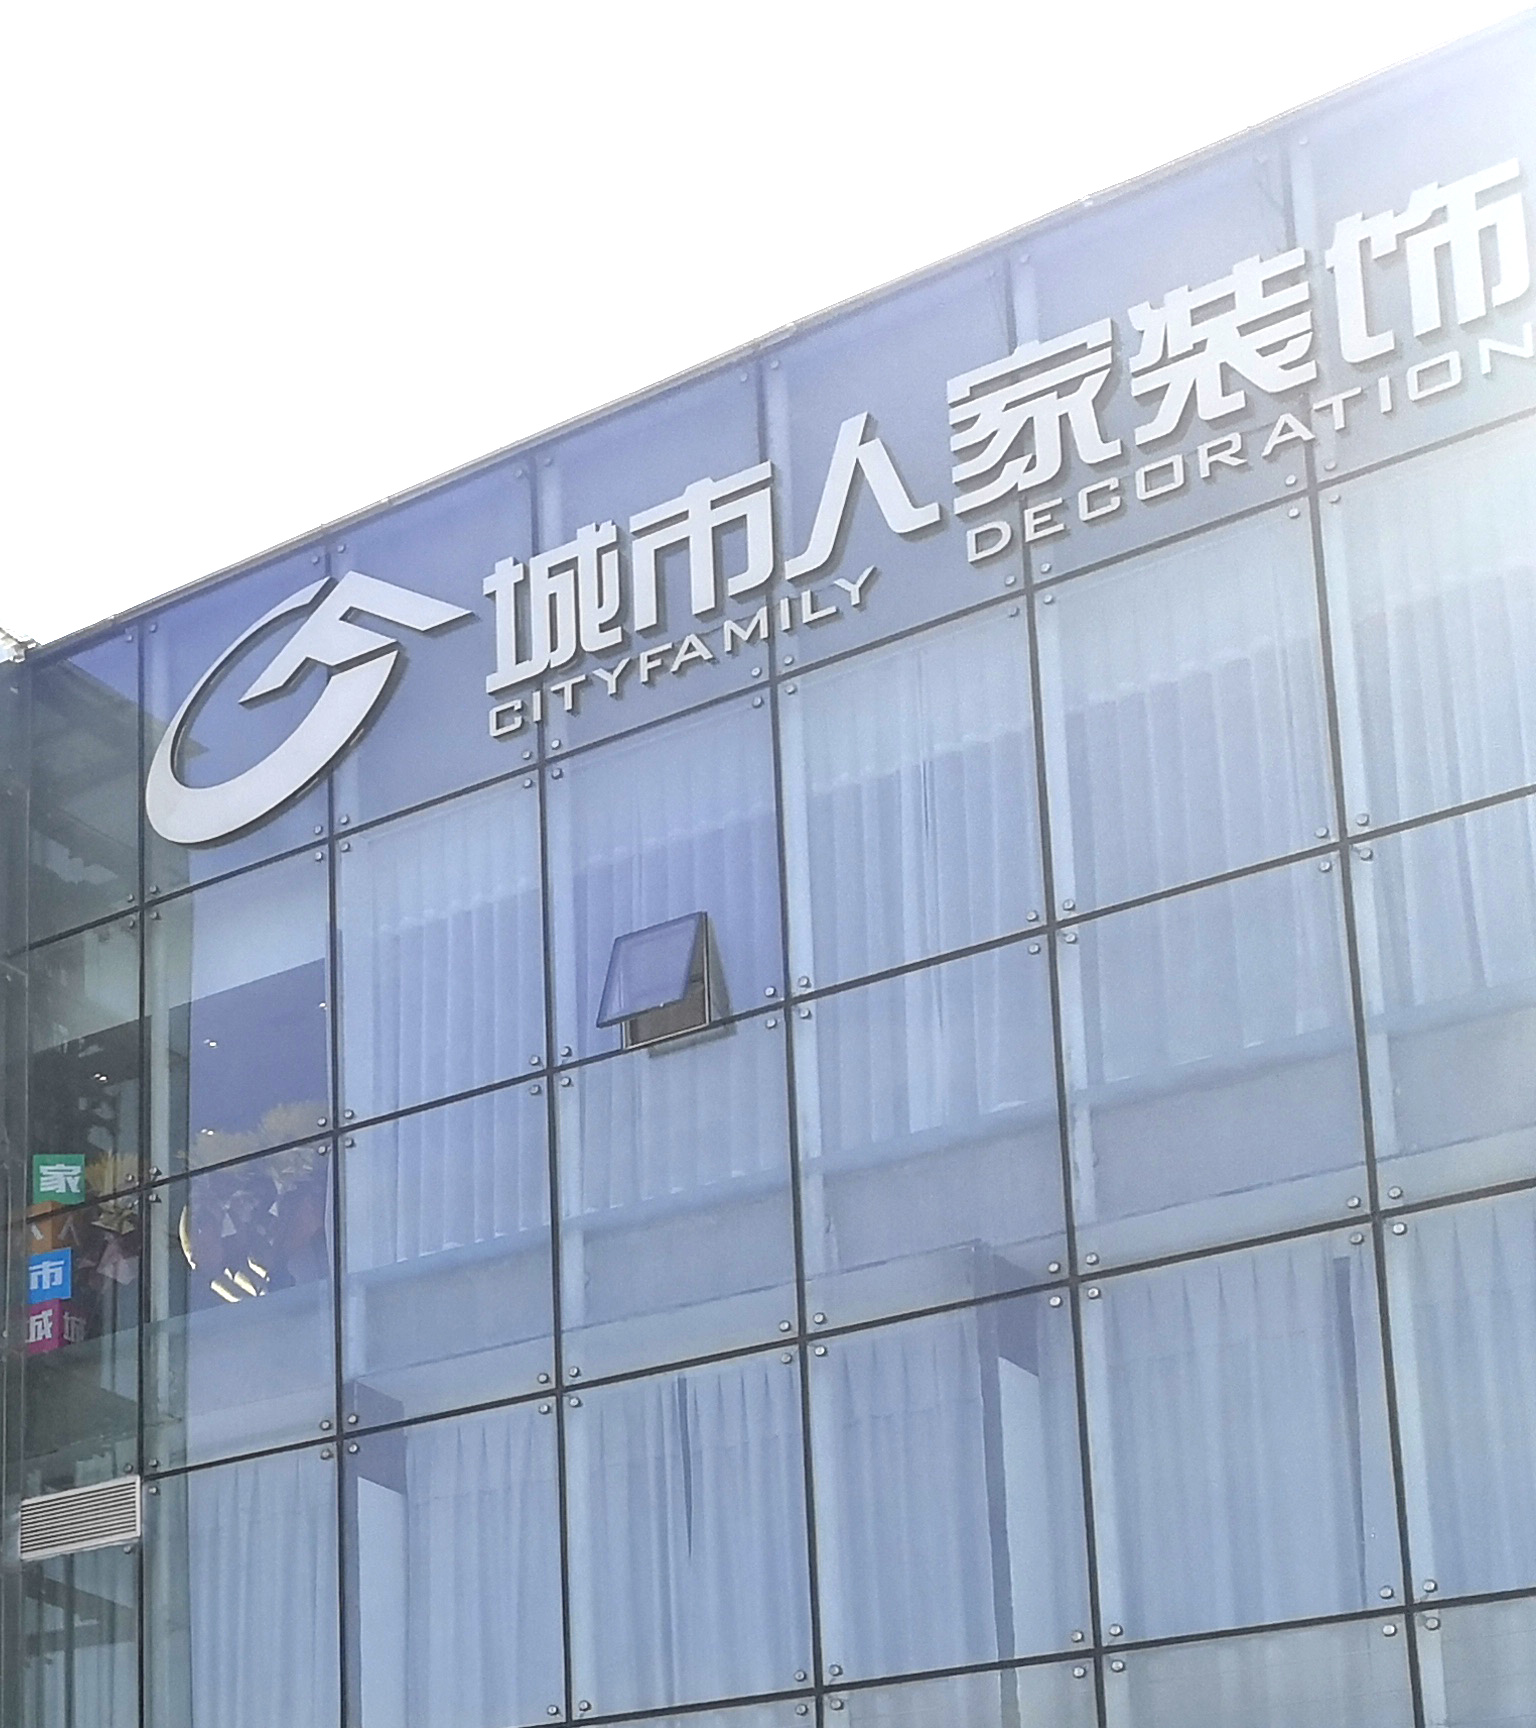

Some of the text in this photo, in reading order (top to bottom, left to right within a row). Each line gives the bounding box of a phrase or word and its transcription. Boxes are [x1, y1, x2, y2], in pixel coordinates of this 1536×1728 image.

[482, 157, 1530, 695] 城市人家装饰
[489, 320, 1534, 739] CITYFAMILY DECORATION
[28, 1260, 65, 1290] 市
[39, 1163, 81, 1193] 家
